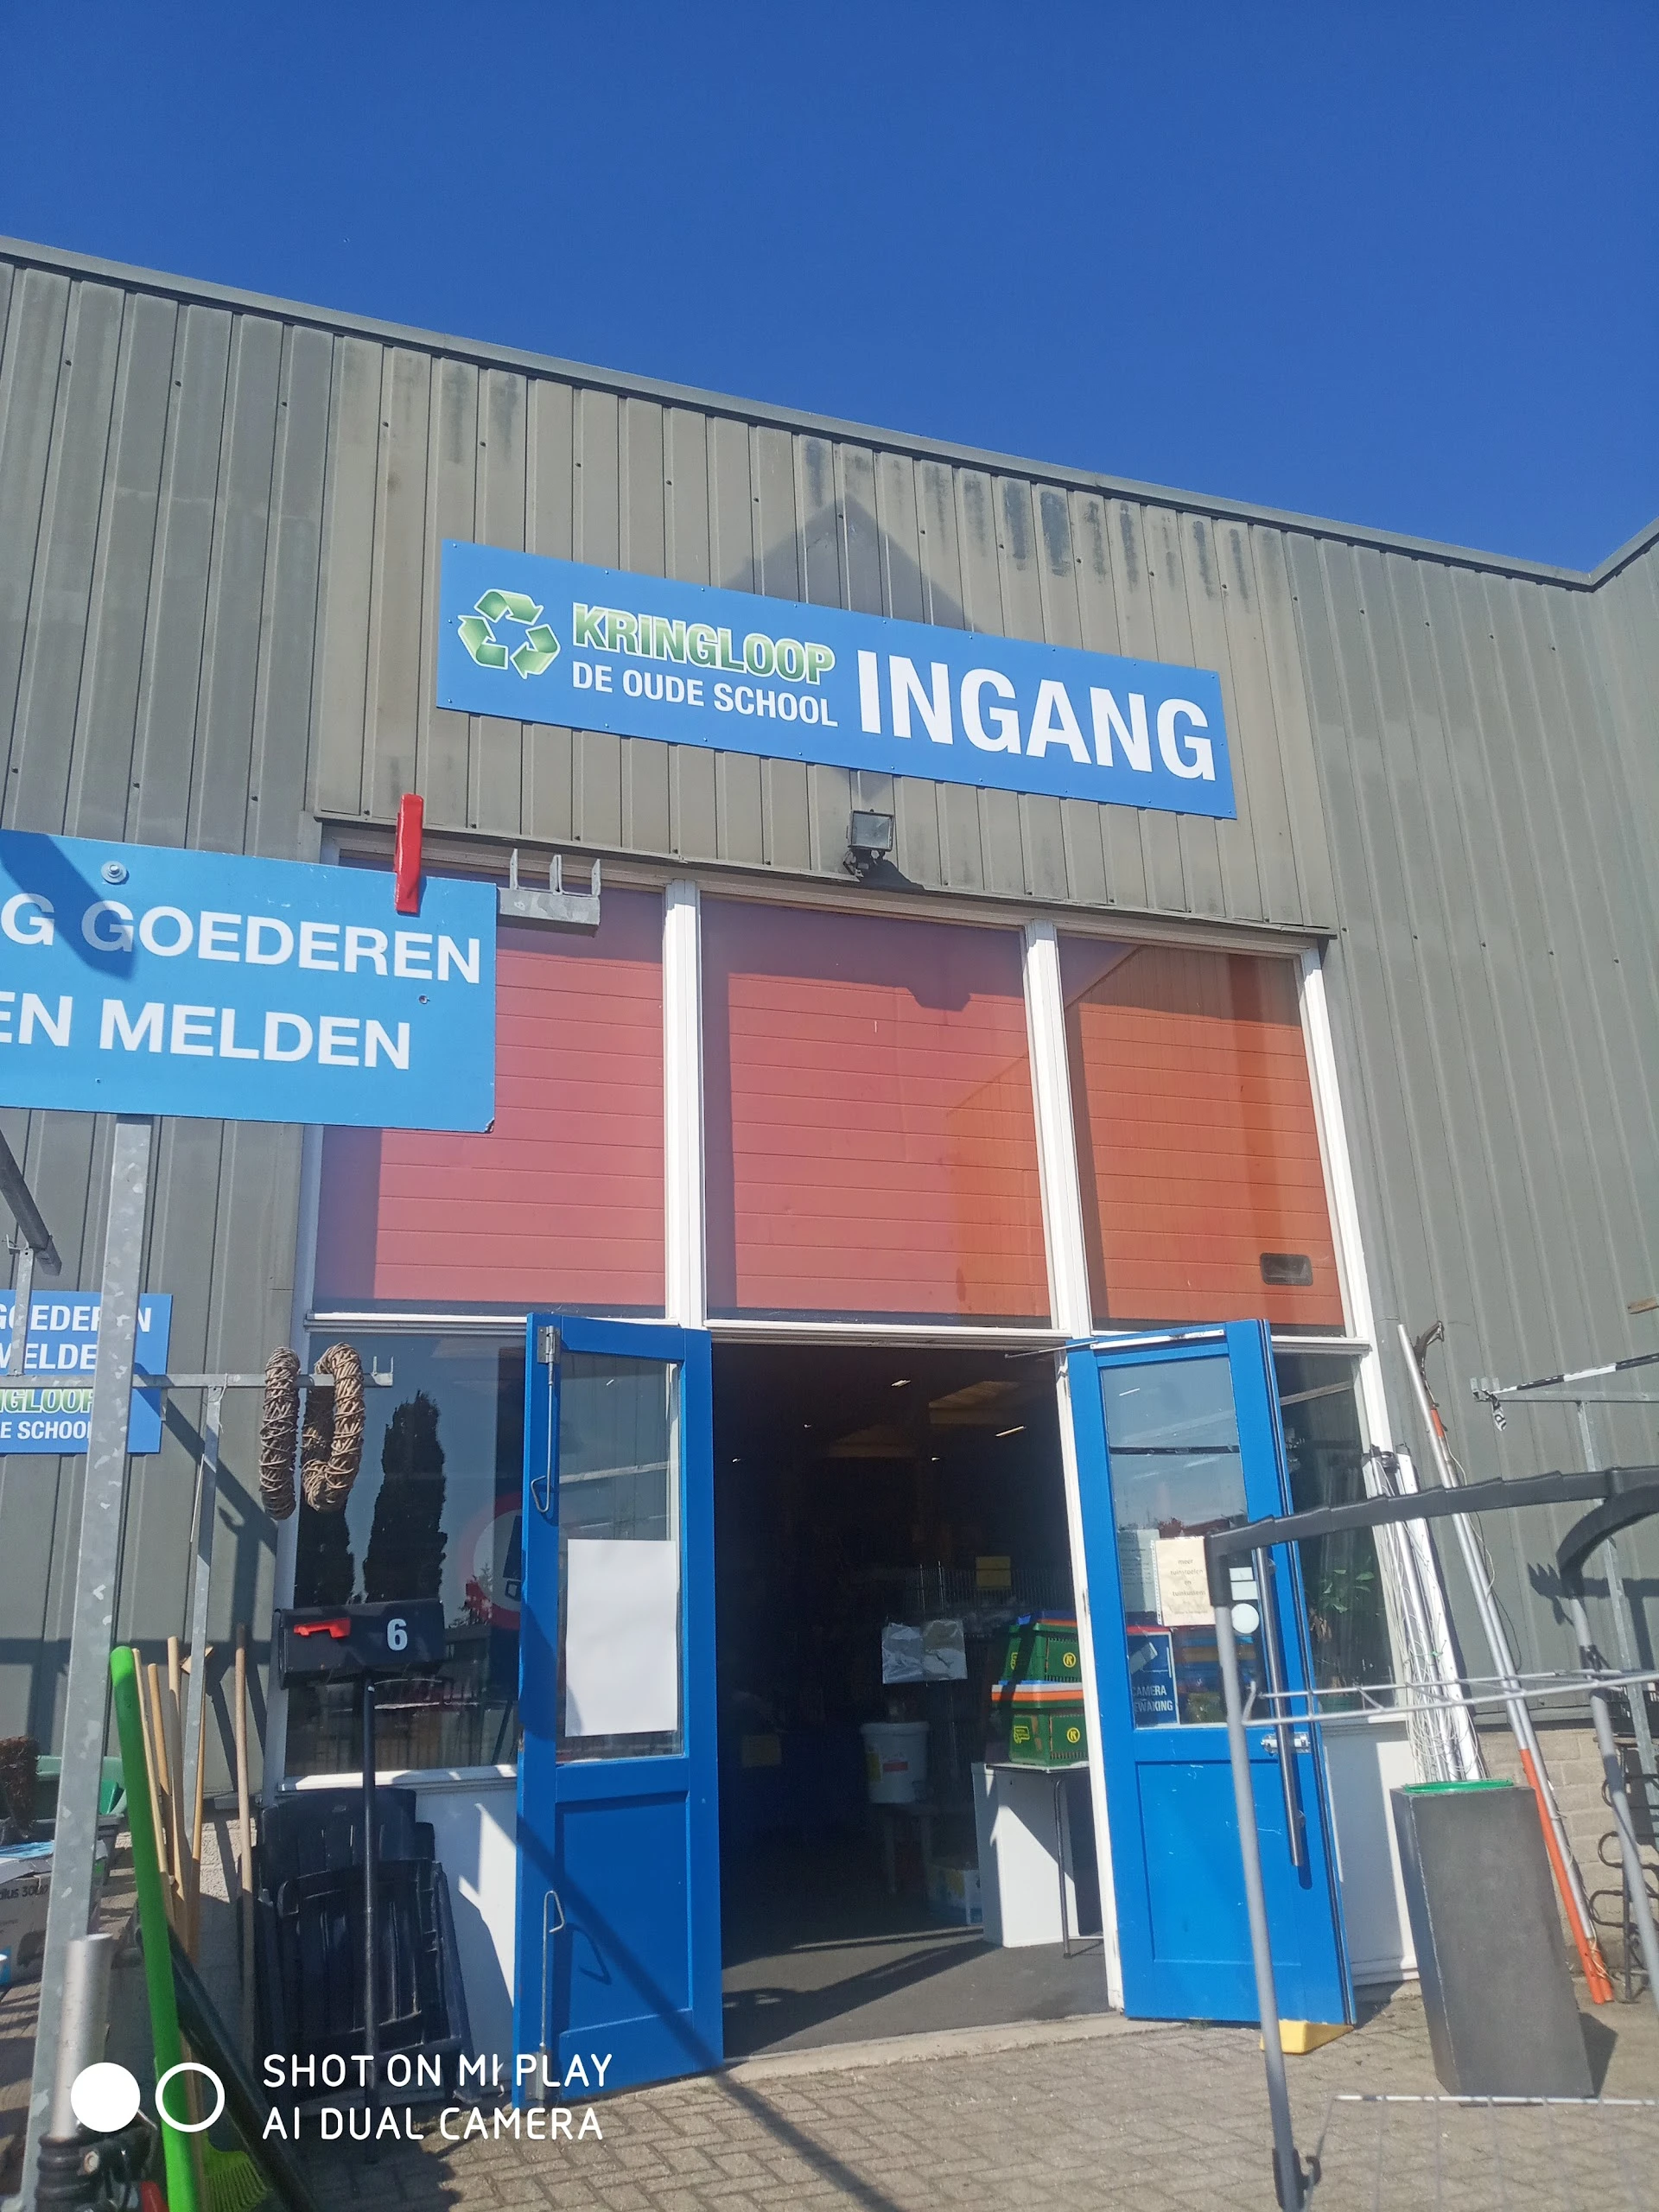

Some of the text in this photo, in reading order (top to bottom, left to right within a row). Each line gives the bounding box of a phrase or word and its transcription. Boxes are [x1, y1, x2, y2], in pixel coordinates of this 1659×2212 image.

[572, 602, 836, 685] KRINGLOOP
[573, 661, 838, 728] DE OUDE SCHOOL
[857, 650, 1216, 781] INGANG
[81, 900, 480, 984] GOEDEREN
[99, 999, 410, 1070] MELDEN
[386, 1618, 408, 1651] 6
[1132, 1685, 1167, 1696] CAMERA
